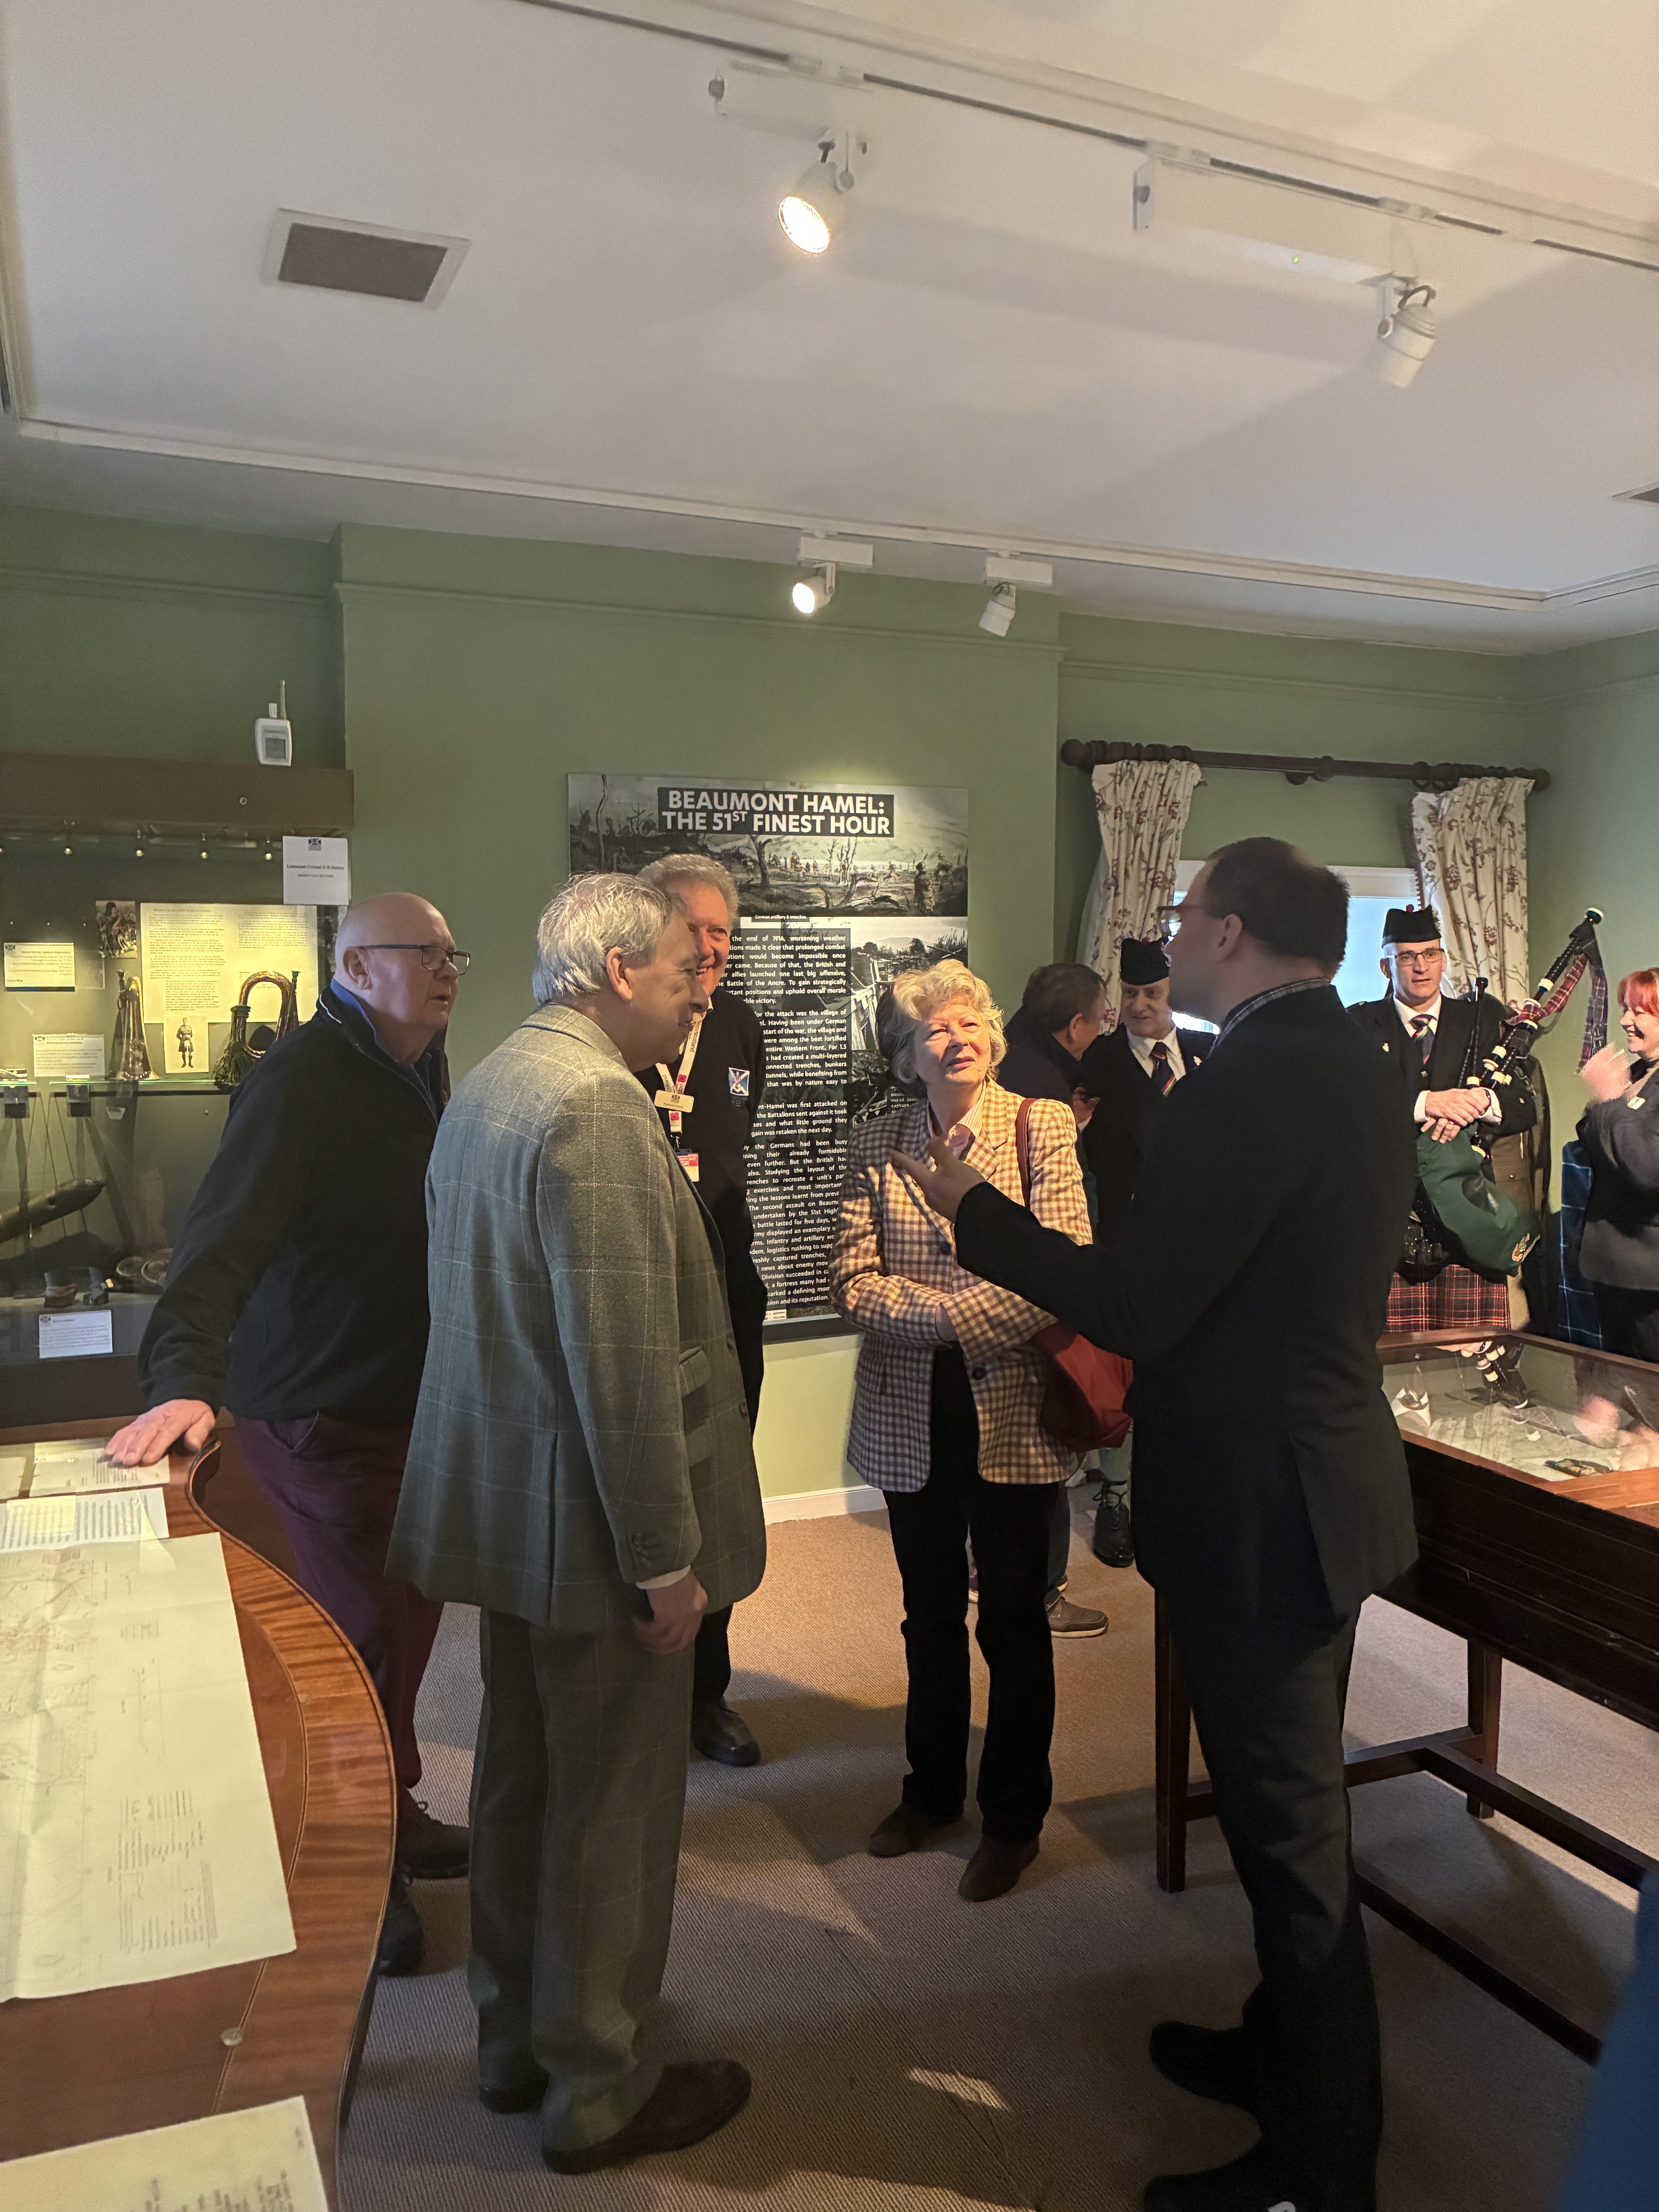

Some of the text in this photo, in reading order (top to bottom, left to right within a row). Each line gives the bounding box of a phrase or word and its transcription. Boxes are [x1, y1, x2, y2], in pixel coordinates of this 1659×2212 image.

[669, 790, 884, 814] BEAUMONT HAMEL:
[662, 811, 890, 834] THE 51ST FINEST HOUR
[813, 978, 846, 987] strategically
